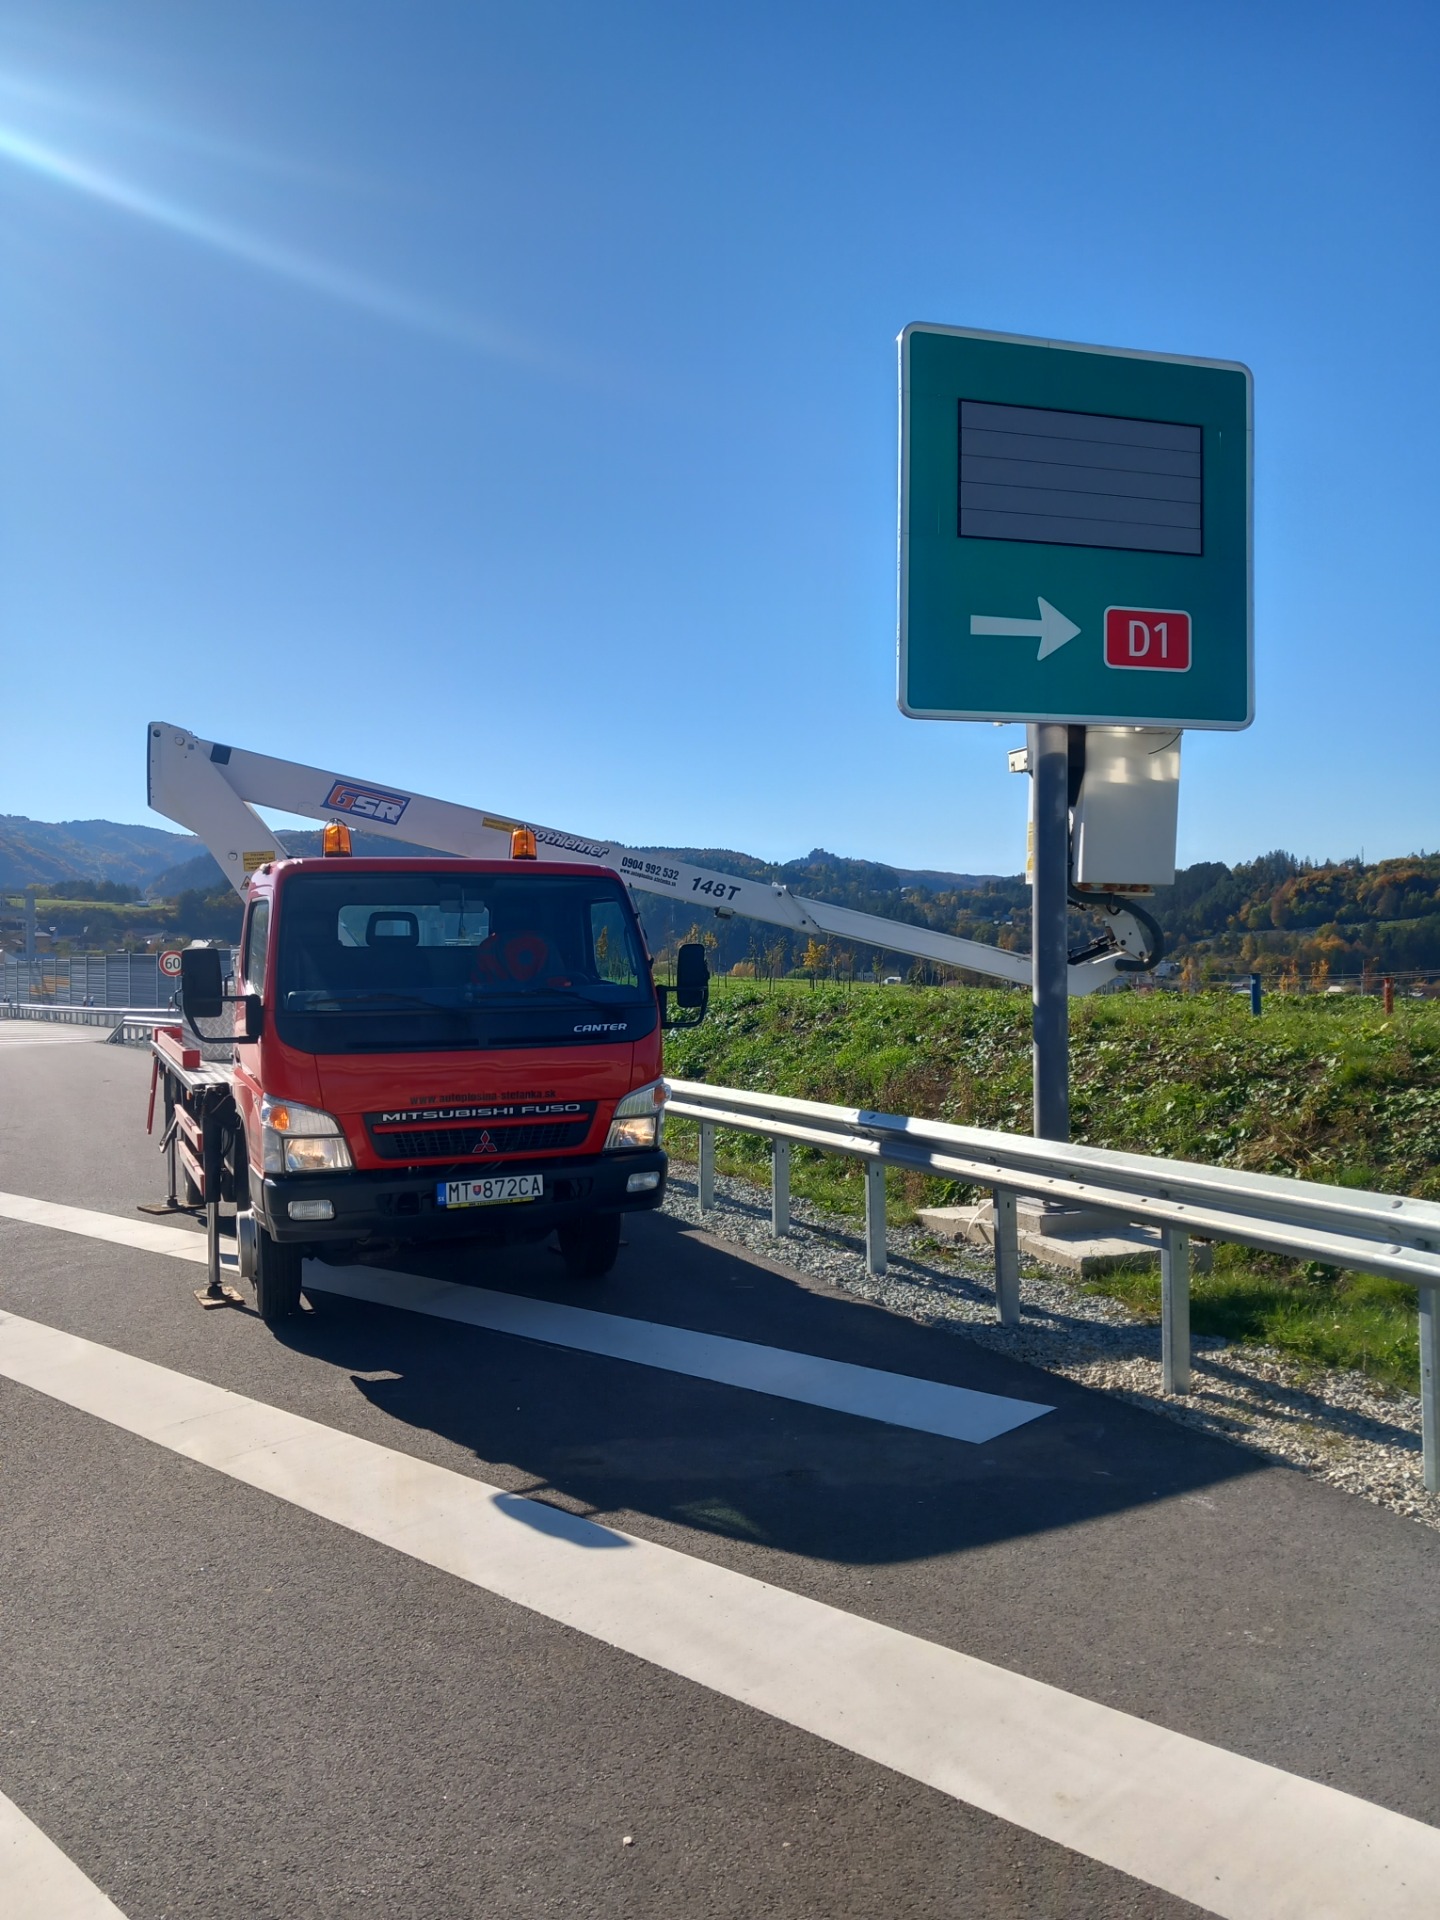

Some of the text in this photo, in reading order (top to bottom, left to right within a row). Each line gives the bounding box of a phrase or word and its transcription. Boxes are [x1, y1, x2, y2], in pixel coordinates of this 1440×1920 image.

[1128, 619, 1168, 659] D1
[328, 784, 403, 823] GSR
[621, 856, 680, 880] 0904 992 532
[692, 876, 741, 901] 148T
[165, 957, 181, 970] 60
[573, 1022, 628, 1033] CANTER
[382, 1103, 581, 1122] MITSUBISHI FUSO
[448, 1176, 541, 1203] MT 872CA
